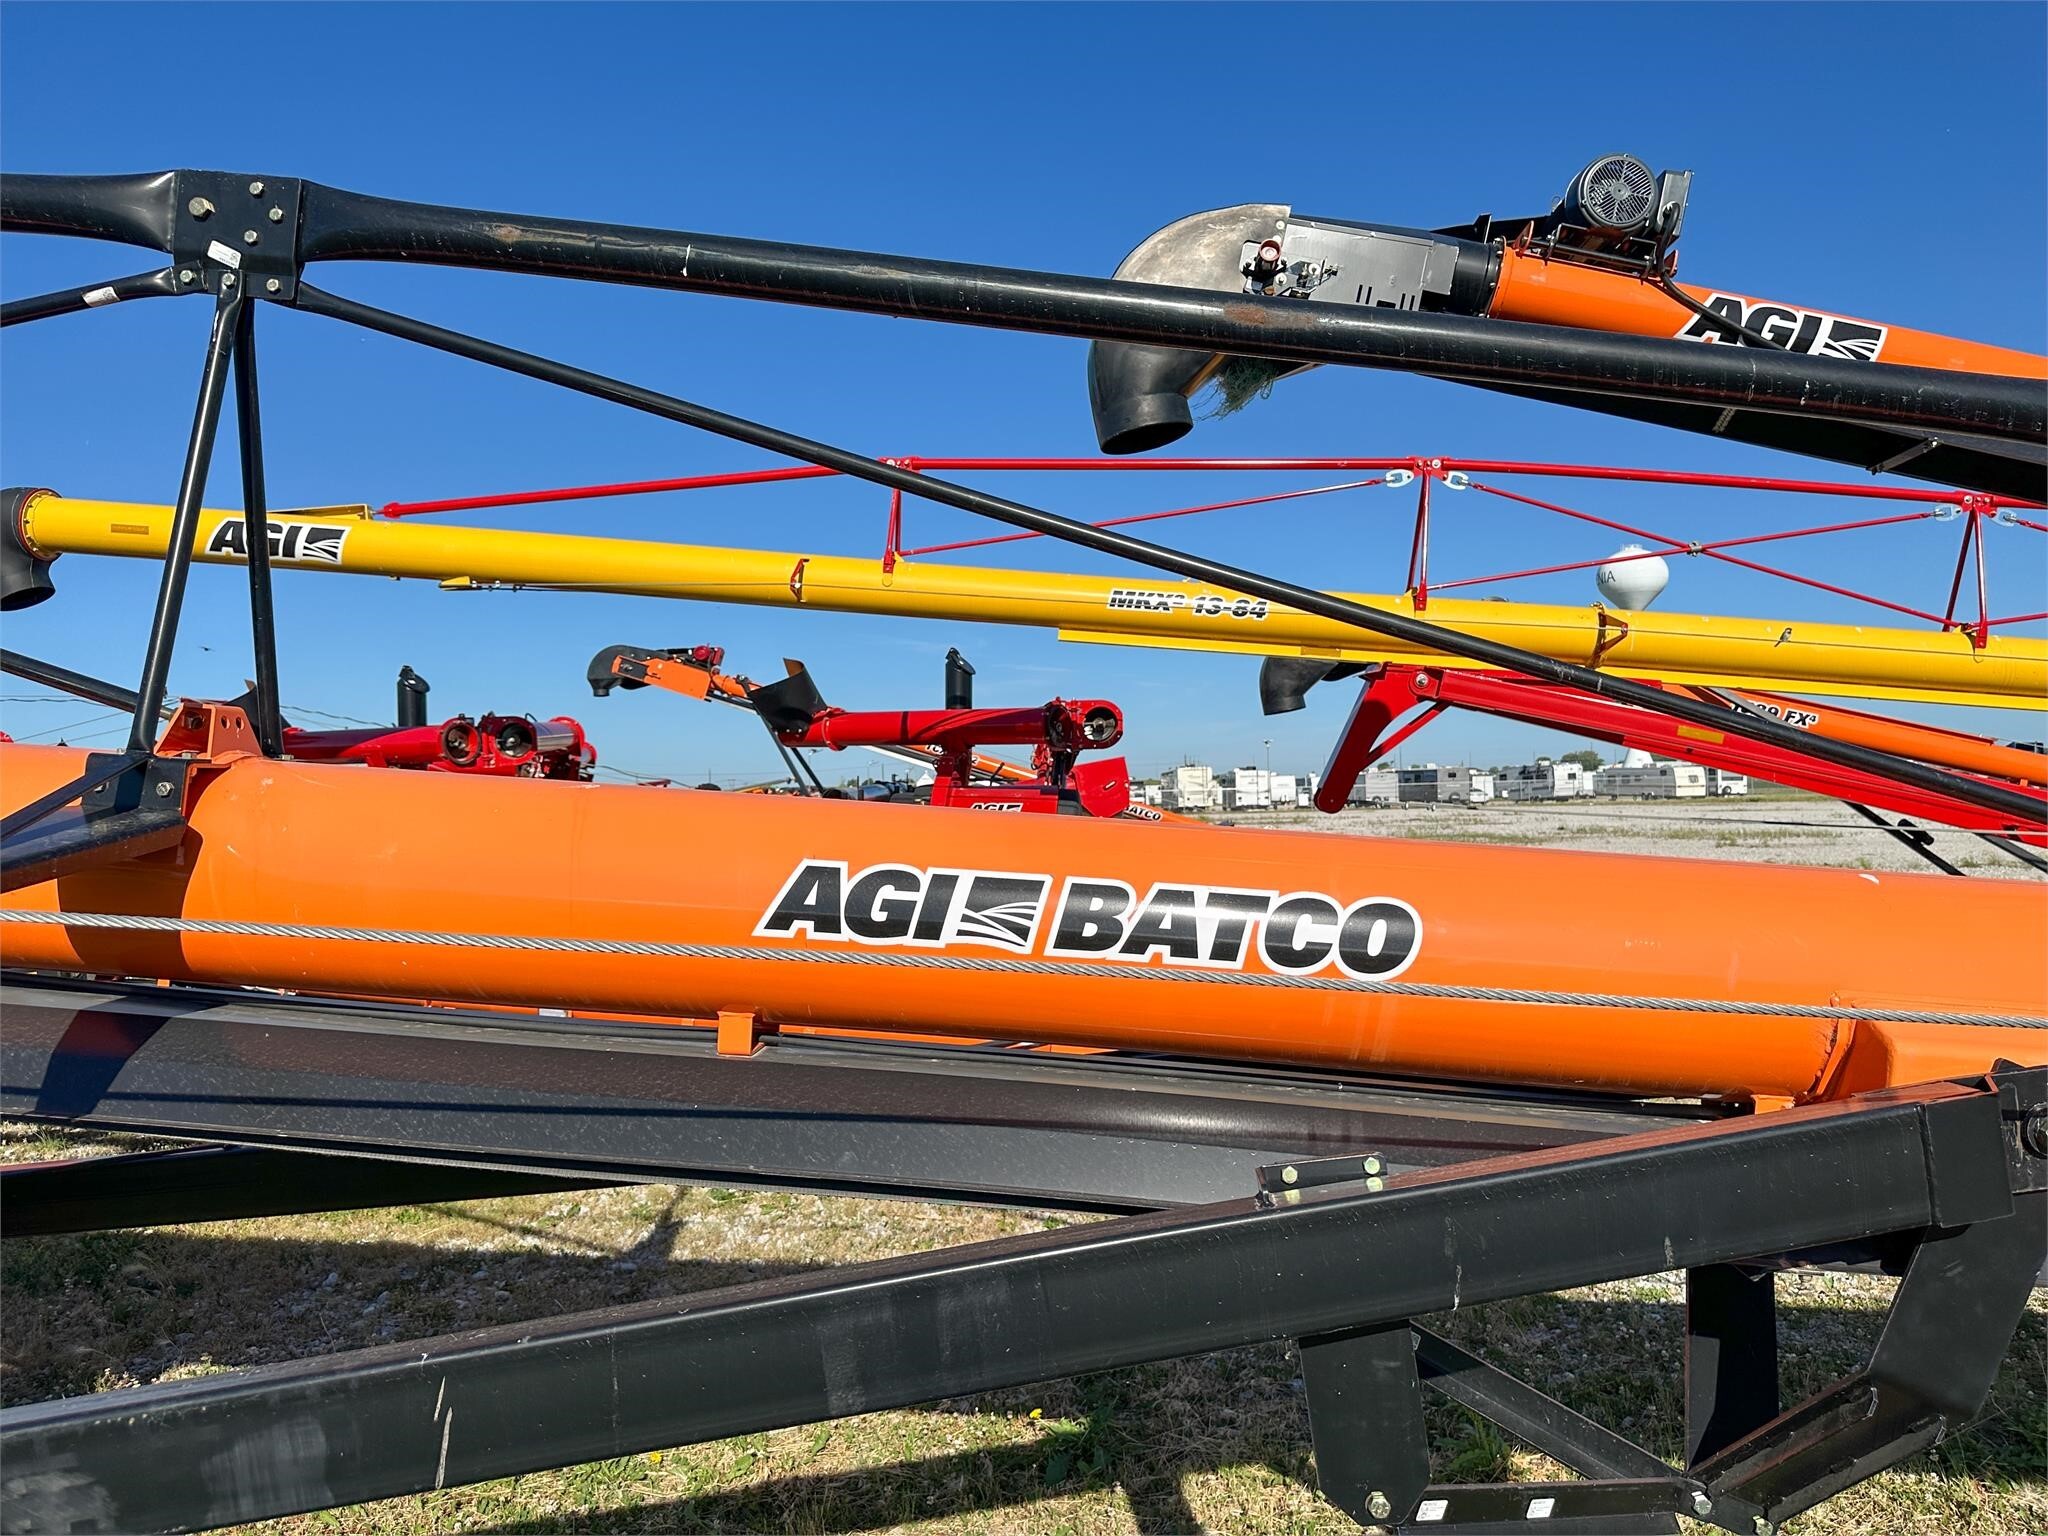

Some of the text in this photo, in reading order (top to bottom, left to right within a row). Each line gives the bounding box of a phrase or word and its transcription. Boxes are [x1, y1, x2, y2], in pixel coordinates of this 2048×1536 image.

[1684, 296, 1822, 354] AGI
[1194, 595, 1268, 619] 13-84
[763, 864, 1417, 974] AGI BATCO
